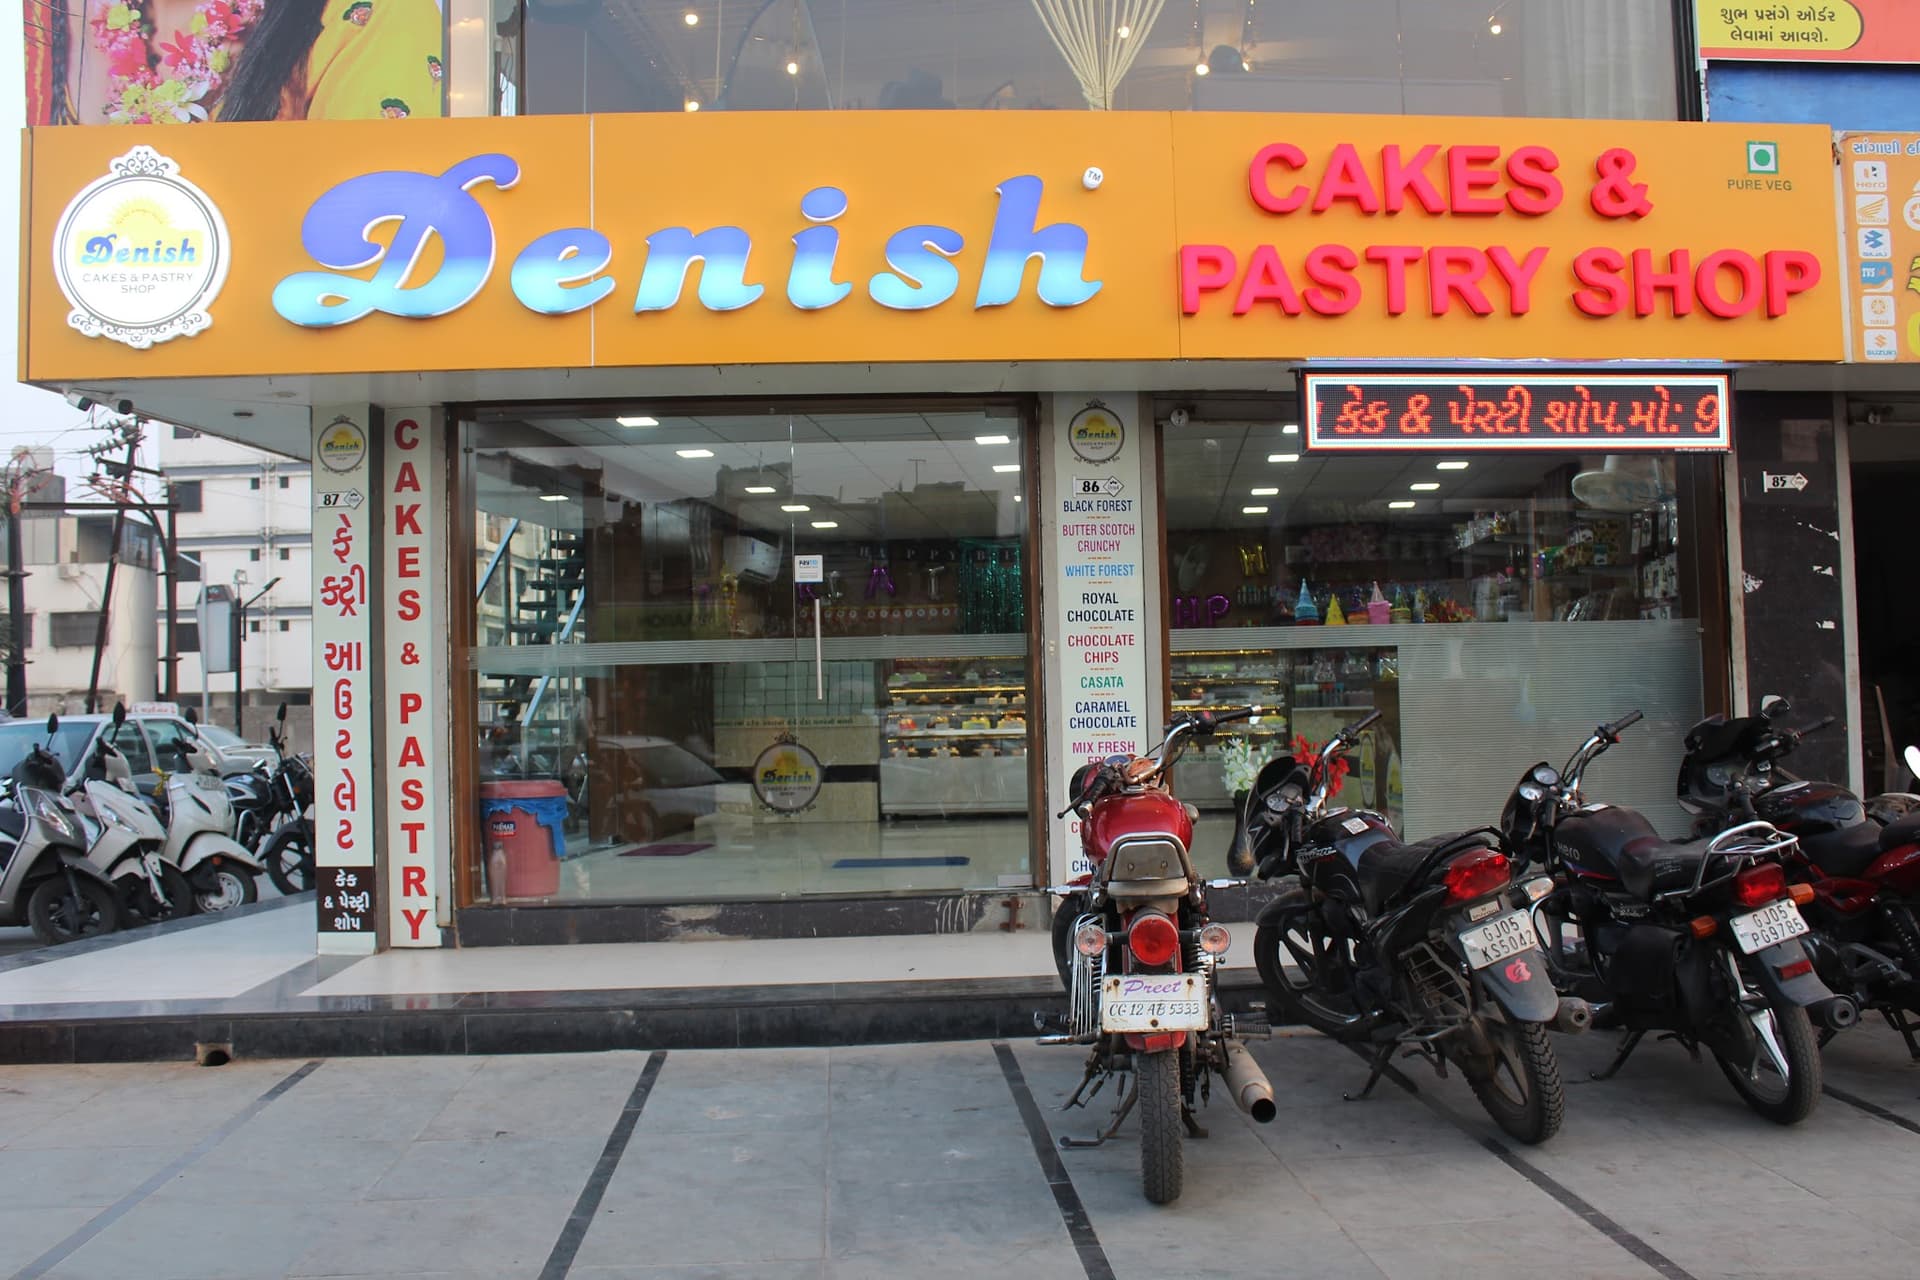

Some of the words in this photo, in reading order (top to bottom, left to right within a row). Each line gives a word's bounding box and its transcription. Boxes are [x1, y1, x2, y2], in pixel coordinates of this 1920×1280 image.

[1720, 7, 1748, 24] શુભ
[1755, 4, 1790, 20] પ્રસંગે
[1796, 5, 1836, 21] ઓર્ડર
[1730, 25, 1773, 41] લેવામાં
[1248, 142, 1565, 218] CAKES
[1591, 147, 1655, 220] &
[1727, 179, 1762, 190] PURE
[1766, 180, 1793, 191] VEG
[272, 153, 1104, 327] Denish
[1088, 170, 1102, 182] TM
[80, 233, 197, 265] Denish
[82, 273, 127, 283] CAKES
[129, 274, 140, 283] &
[142, 273, 194, 283] PASTRY
[1179, 244, 1550, 316] PASTRY
[1572, 246, 1822, 318] SHOP
[121, 284, 156, 294] SHOP
[1399, 393, 1433, 433] &
[1082, 480, 1100, 493] 86
[323, 493, 340, 506] 87
[1063, 500, 1094, 512] BLACK
[1096, 500, 1133, 512] FOREST
[393, 418, 423, 621] CAKES
[1062, 524, 1097, 537] BUTTER
[1099, 523, 1136, 536] SCOTCH
[1077, 540, 1121, 552] CRUNCHY
[1065, 565, 1095, 577] WHITE
[1098, 564, 1136, 577] FOREST
[1082, 592, 1119, 605] ROYAL
[1067, 609, 1135, 623] CHOCOLATE
[1067, 634, 1135, 648] CHOCOLATE
[400, 641, 420, 666] &
[1084, 651, 1120, 664] CHIPS
[1080, 676, 1125, 689] CASATA
[1075, 700, 1131, 714] CARAMEL
[1069, 715, 1137, 729] CHOCOLATE
[1072, 742, 1094, 754] MIX
[1097, 741, 1136, 753] FRESH
[397, 693, 428, 941] PASTRY
[334, 868, 358, 887] કેક
[323, 895, 335, 909] &
[334, 912, 361, 930] શોપ
[1751, 904, 1788, 928] GJ05
[1482, 916, 1520, 942] GJ05
[1751, 917, 1805, 947] PG9785
[1481, 929, 1535, 962] KS5042
[1123, 979, 1182, 997] Preet
[1109, 1003, 1127, 1017] CG
[1129, 1003, 1144, 1016] 12
[1168, 1002, 1200, 1016] 5333
